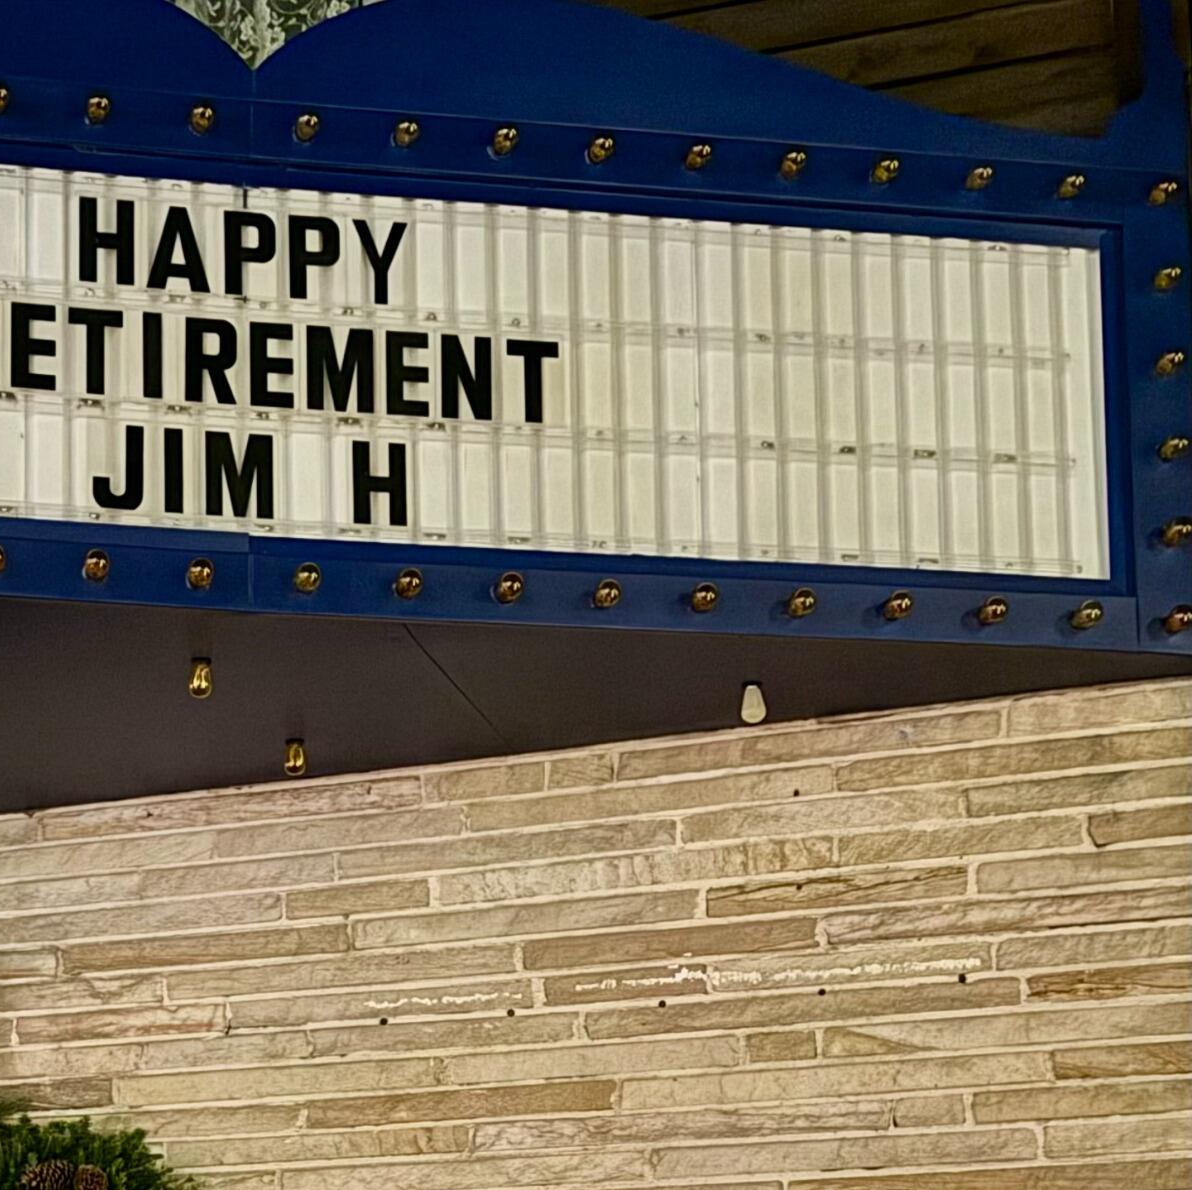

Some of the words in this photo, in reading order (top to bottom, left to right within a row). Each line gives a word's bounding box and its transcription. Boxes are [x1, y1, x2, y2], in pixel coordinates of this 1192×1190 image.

[78, 196, 407, 305] HAPPY
[92, 425, 274, 519] JIM
[352, 440, 408, 527] H
